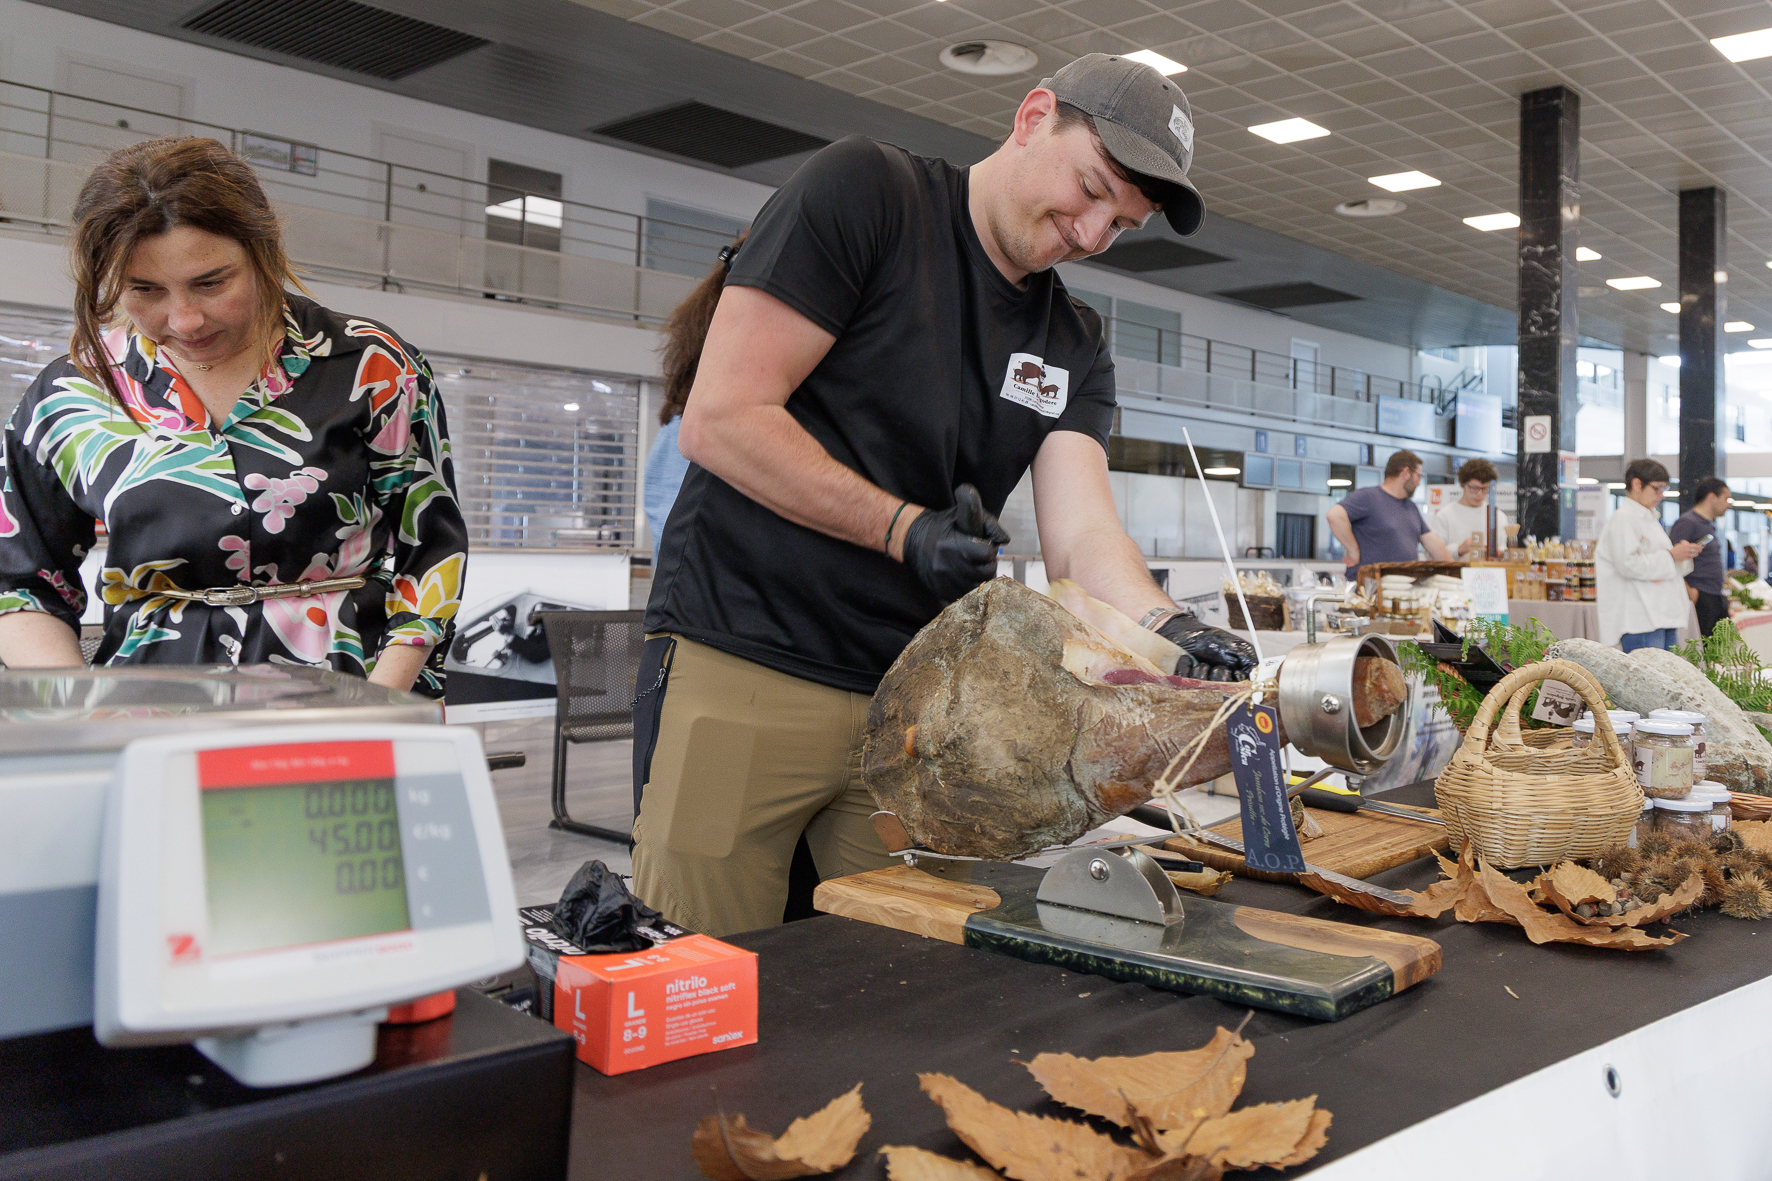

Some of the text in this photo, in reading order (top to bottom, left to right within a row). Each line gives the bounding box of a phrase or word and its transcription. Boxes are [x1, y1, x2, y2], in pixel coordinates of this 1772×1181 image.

[1013, 383, 1036, 396] Camille
[304, 782, 392, 819] 0.000
[408, 788, 431, 806] kg
[1268, 748, 1291, 841] Appellation d'Origine Protégée
[1252, 769, 1267, 802] Jambon
[1261, 826, 1272, 849] Corse
[308, 819, 396, 857] 45.00
[1247, 848, 1305, 870] A.O.P.
[336, 856, 401, 896] 0.00
[665, 975, 708, 995] nitrilo
[665, 981, 737, 1004] nitriflex black soft
[574, 988, 586, 1021] L
[627, 990, 645, 1019] L
[665, 1003, 683, 1011] negro
[692, 998, 707, 1007] polvo
[707, 994, 729, 1002] examen
[623, 1025, 647, 1042] 8-9
